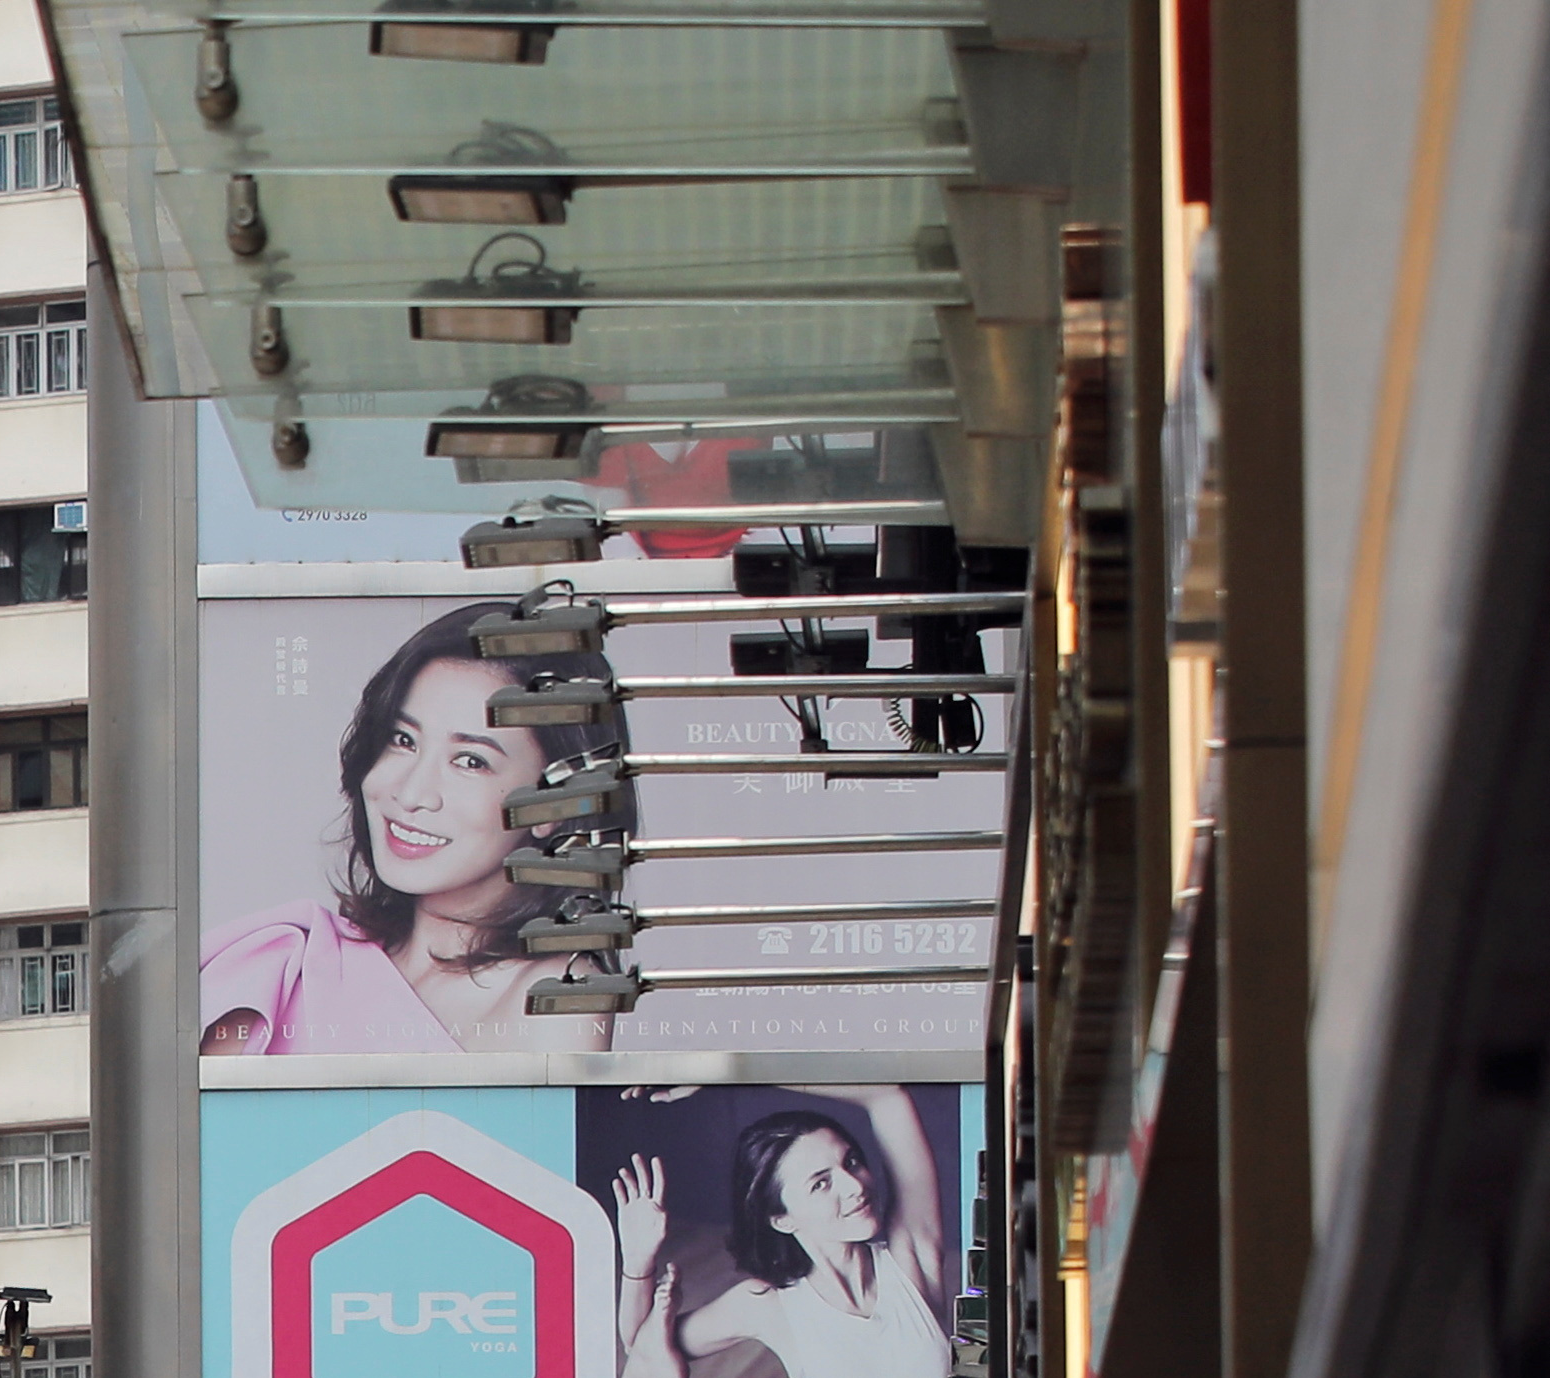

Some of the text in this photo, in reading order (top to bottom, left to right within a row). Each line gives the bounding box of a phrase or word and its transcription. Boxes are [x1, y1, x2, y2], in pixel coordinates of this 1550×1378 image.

[687, 721, 801, 744] BEAUTY
[809, 922, 977, 955] 2116 5232
[364, 1021, 541, 1040] SIGNATUR
[873, 1018, 982, 1036] GROUP
[331, 1290, 517, 1335] PURE
[470, 1341, 518, 1353] YOGA
